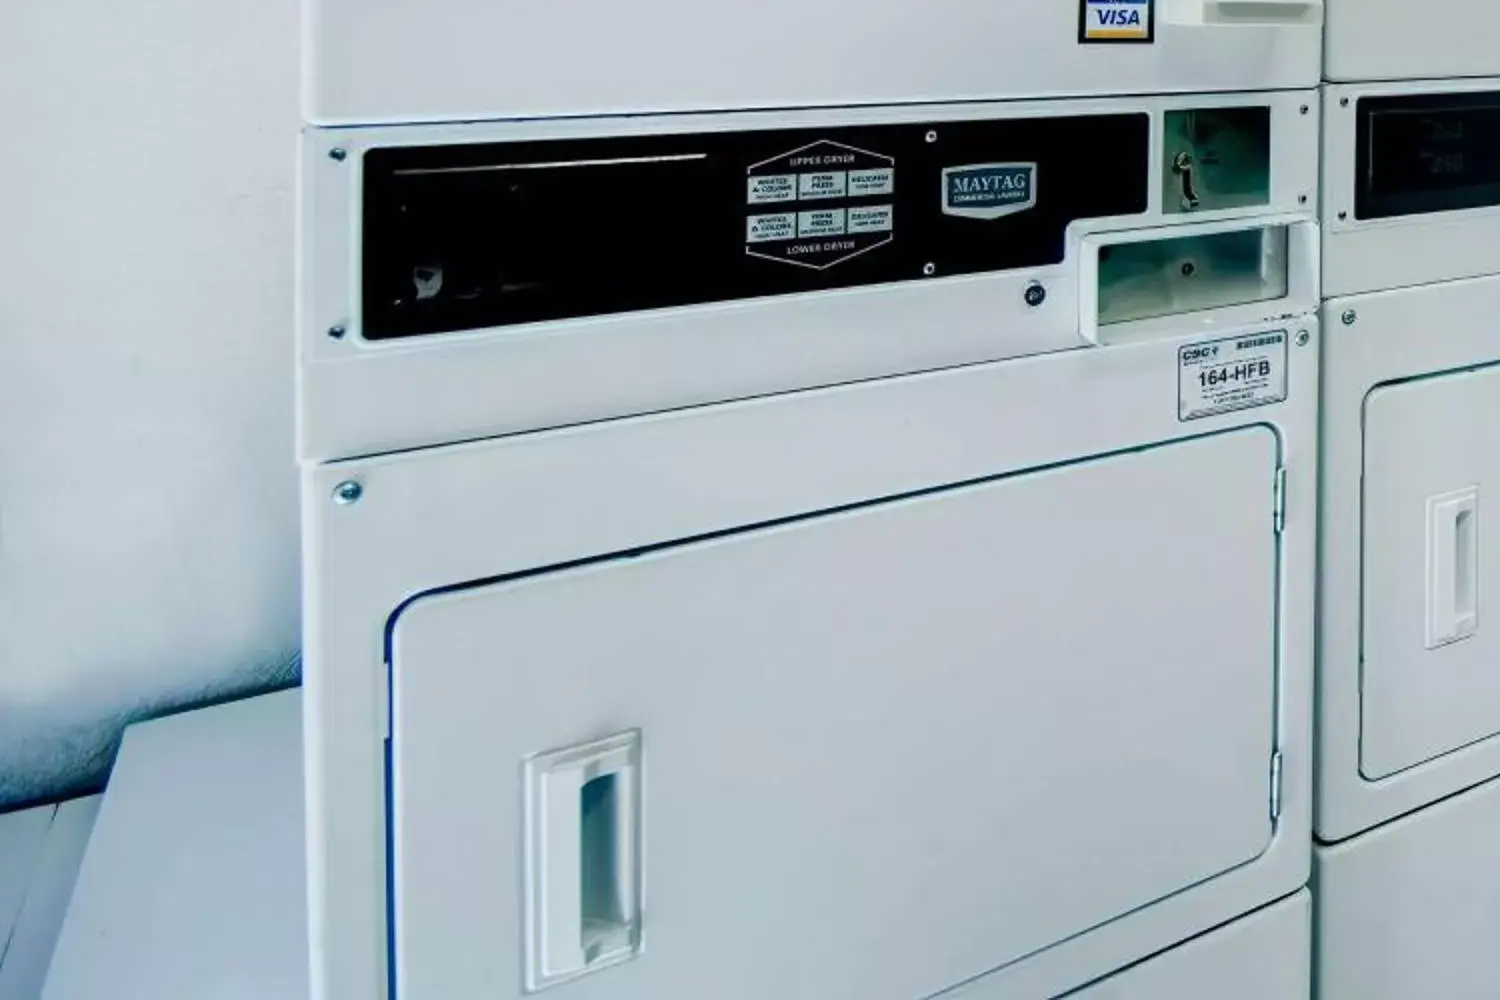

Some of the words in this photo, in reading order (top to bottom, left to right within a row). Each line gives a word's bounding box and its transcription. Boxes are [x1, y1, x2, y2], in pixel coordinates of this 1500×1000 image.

[1097, 9, 1140, 25] VISA
[789, 155, 821, 167] UPPER
[824, 153, 855, 165] DRYER
[953, 173, 1026, 193] MAYTAG
[786, 243, 821, 255] LOWER
[823, 240, 855, 251] DRYER
[1199, 360, 1271, 387] 164-HFB
